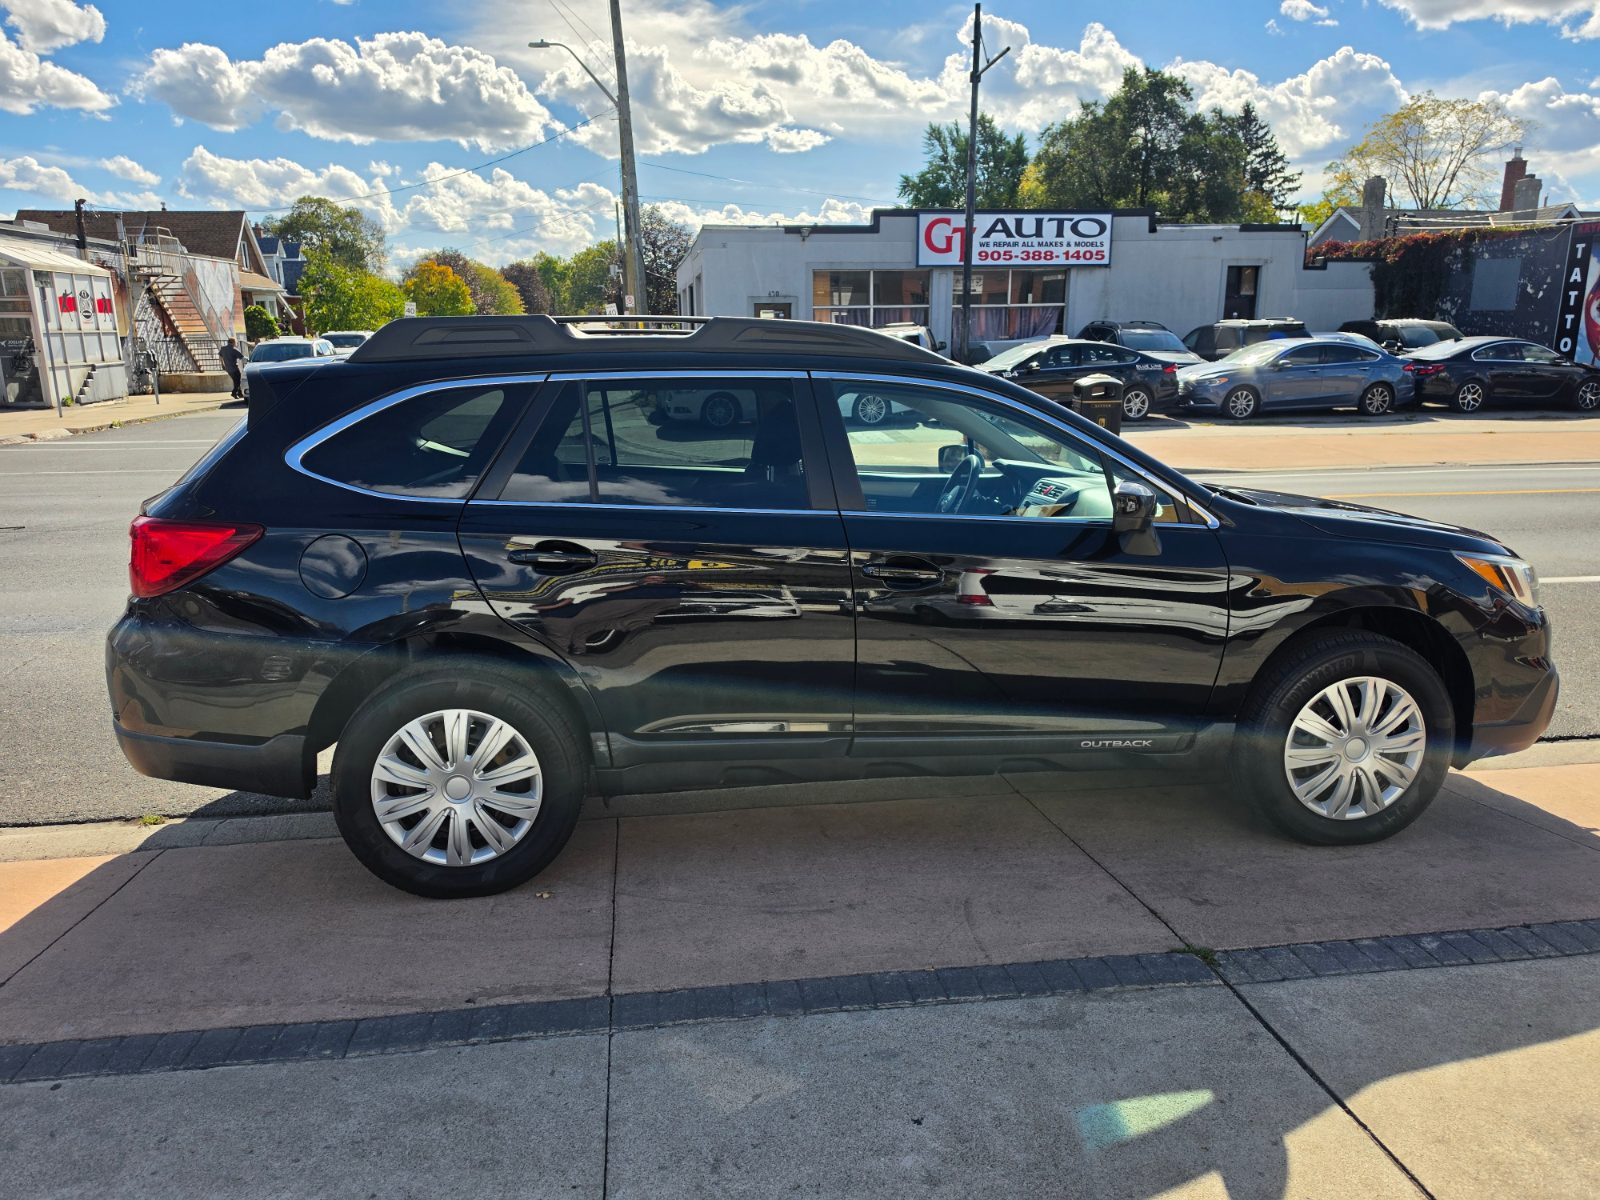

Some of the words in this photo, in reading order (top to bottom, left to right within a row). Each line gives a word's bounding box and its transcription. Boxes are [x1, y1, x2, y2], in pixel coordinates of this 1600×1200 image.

[981, 218, 1107, 238] AUTO
[1074, 240, 1104, 248] MODELS
[978, 249, 1105, 261] 905-388-1405
[1080, 739, 1153, 748] OUTBACK
